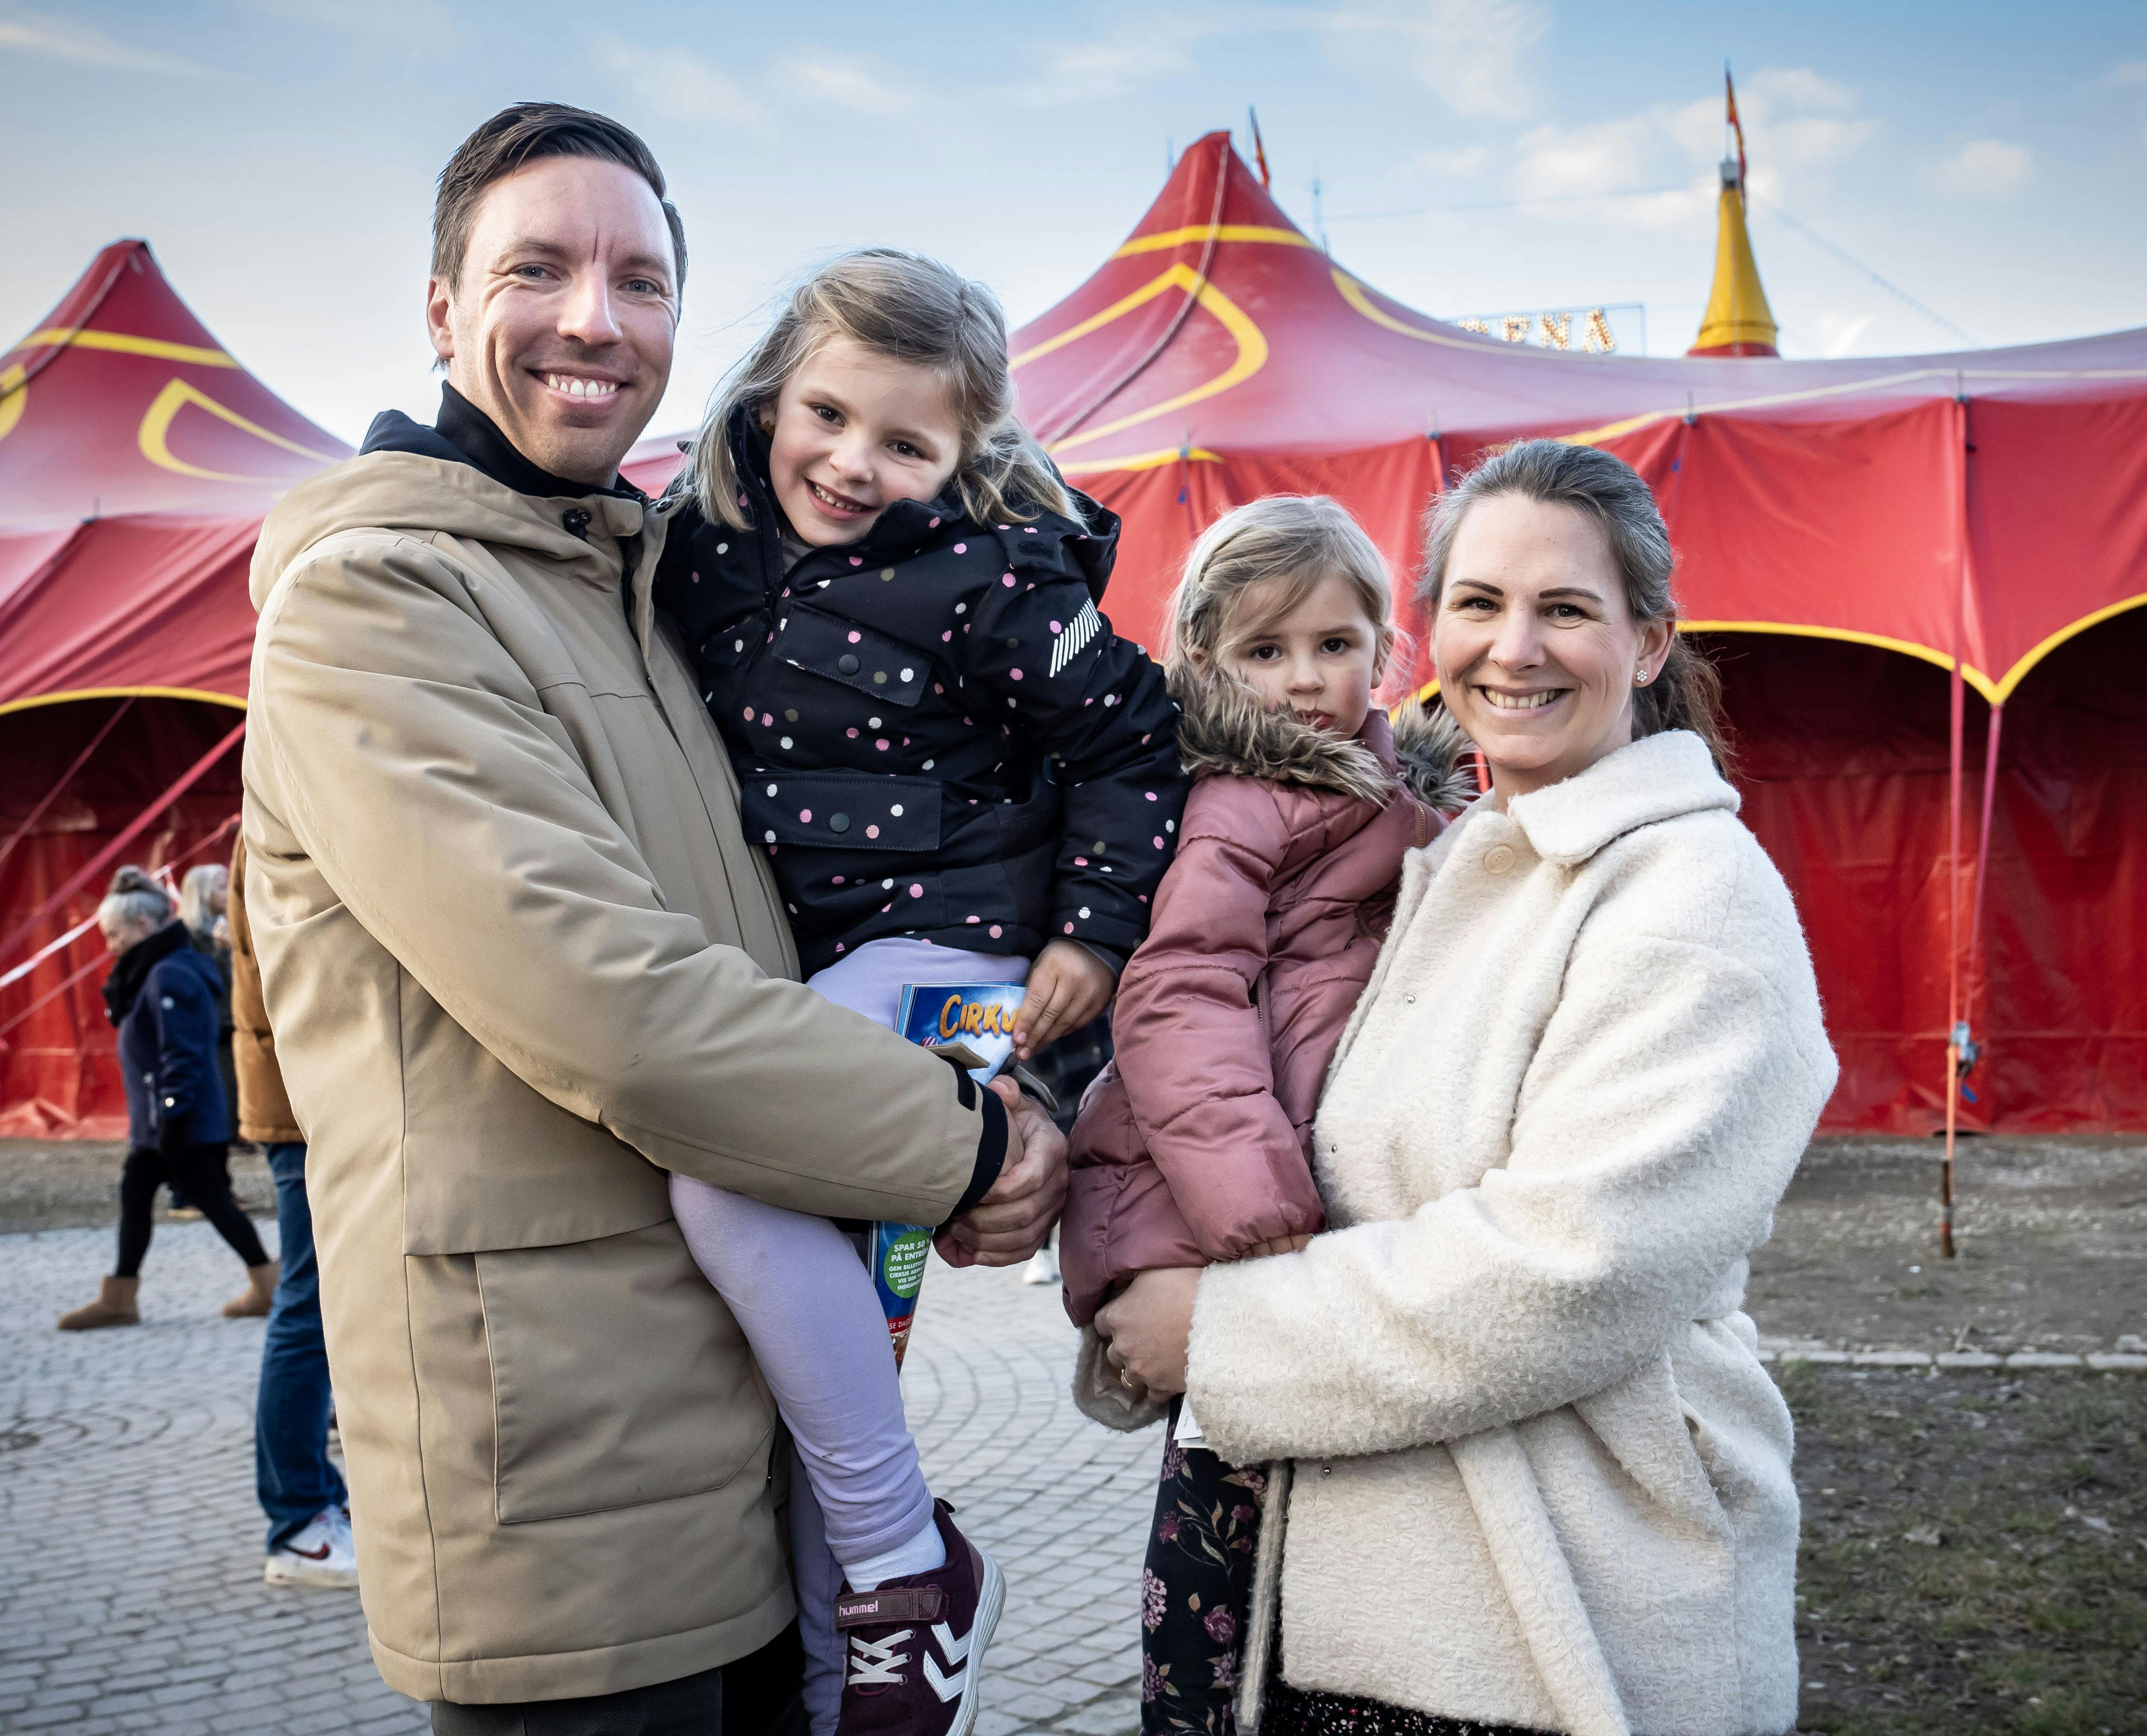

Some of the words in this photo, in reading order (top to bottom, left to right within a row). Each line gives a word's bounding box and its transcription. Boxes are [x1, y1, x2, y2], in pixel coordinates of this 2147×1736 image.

[894, 1243, 915, 1252] SPAR
[917, 1240, 925, 1249] 50
[891, 1252, 902, 1262] PÅ
[889, 1271, 909, 1279] CIRKUS
[839, 1601, 878, 1617] hummel
